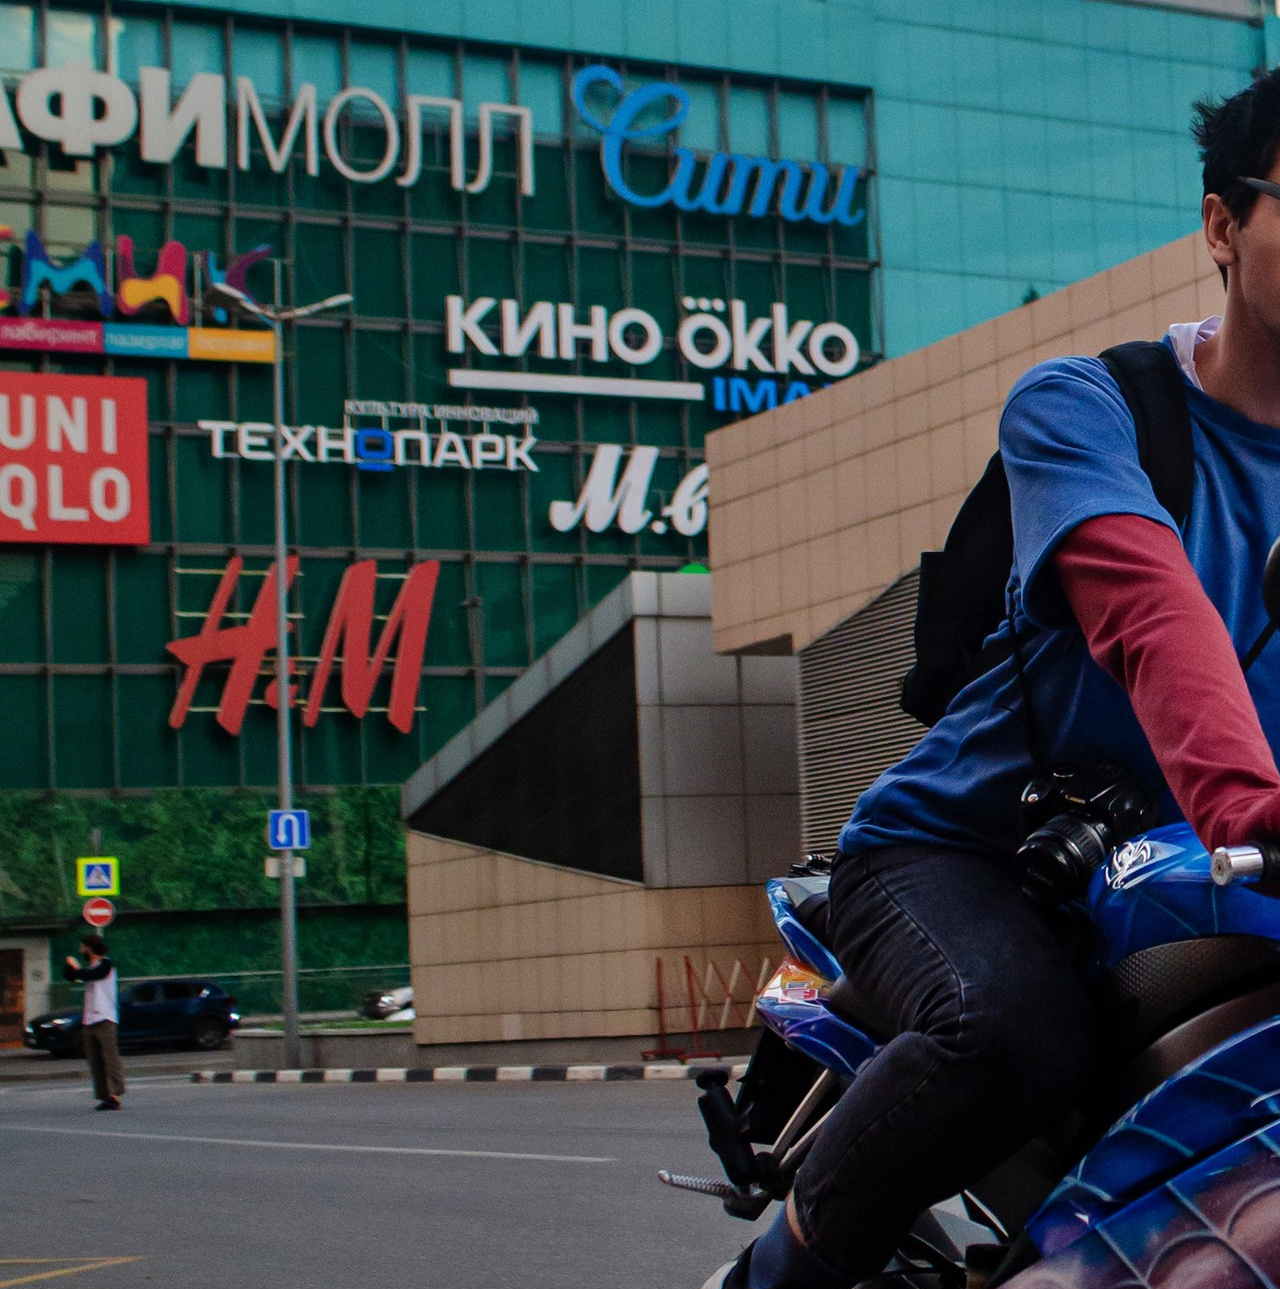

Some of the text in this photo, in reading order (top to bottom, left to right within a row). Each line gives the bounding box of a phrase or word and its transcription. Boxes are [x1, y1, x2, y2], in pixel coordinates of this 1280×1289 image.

[572, 64, 865, 226] Сити
[445, 295, 664, 365] КИНО
[0, 393, 118, 454] UNI
[713, 376, 831, 412] IMA
[197, 420, 540, 472] ТЕХНОПАРК
[0, 463, 131, 531] QLO
